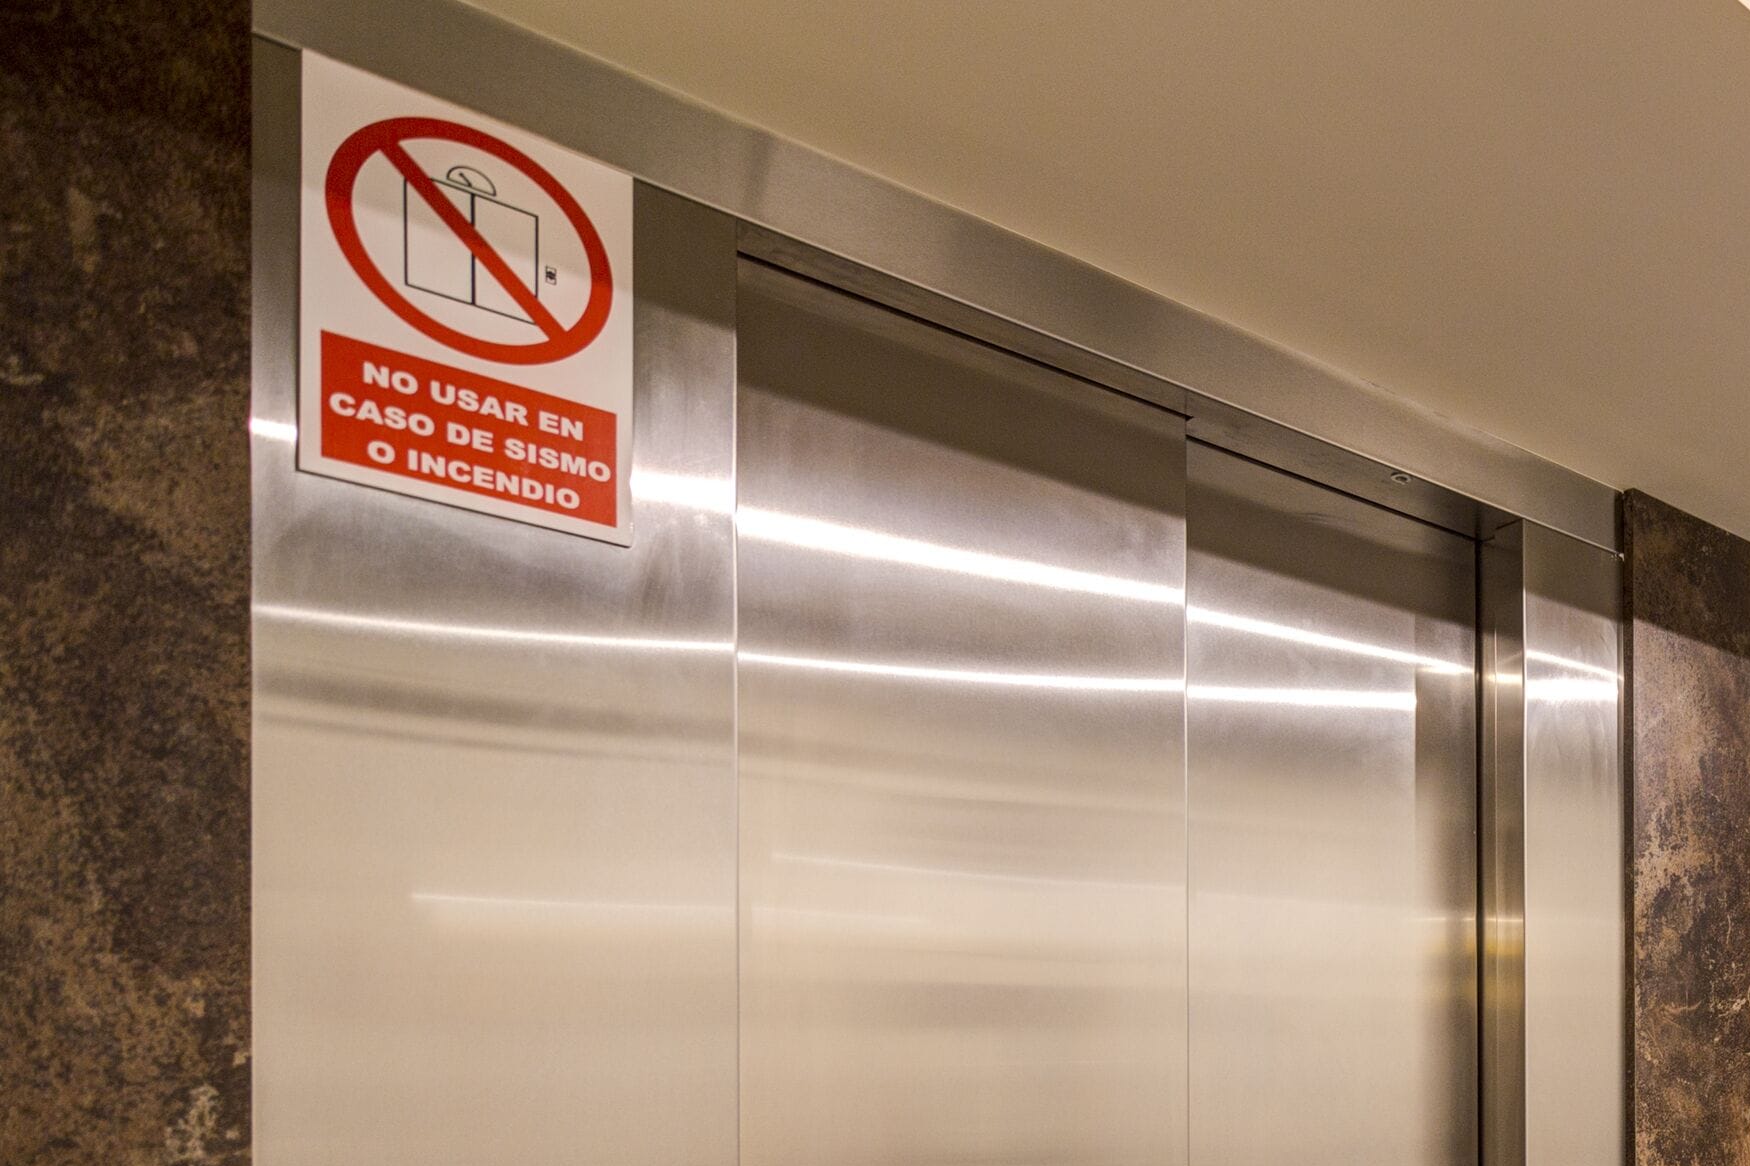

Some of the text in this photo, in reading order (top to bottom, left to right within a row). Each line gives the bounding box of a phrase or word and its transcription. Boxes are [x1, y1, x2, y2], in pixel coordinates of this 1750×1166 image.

[328, 392, 612, 482] CASO DE SISMO
[362, 361, 584, 441] NO USAR EN
[366, 440, 581, 510] O INCENDIO
